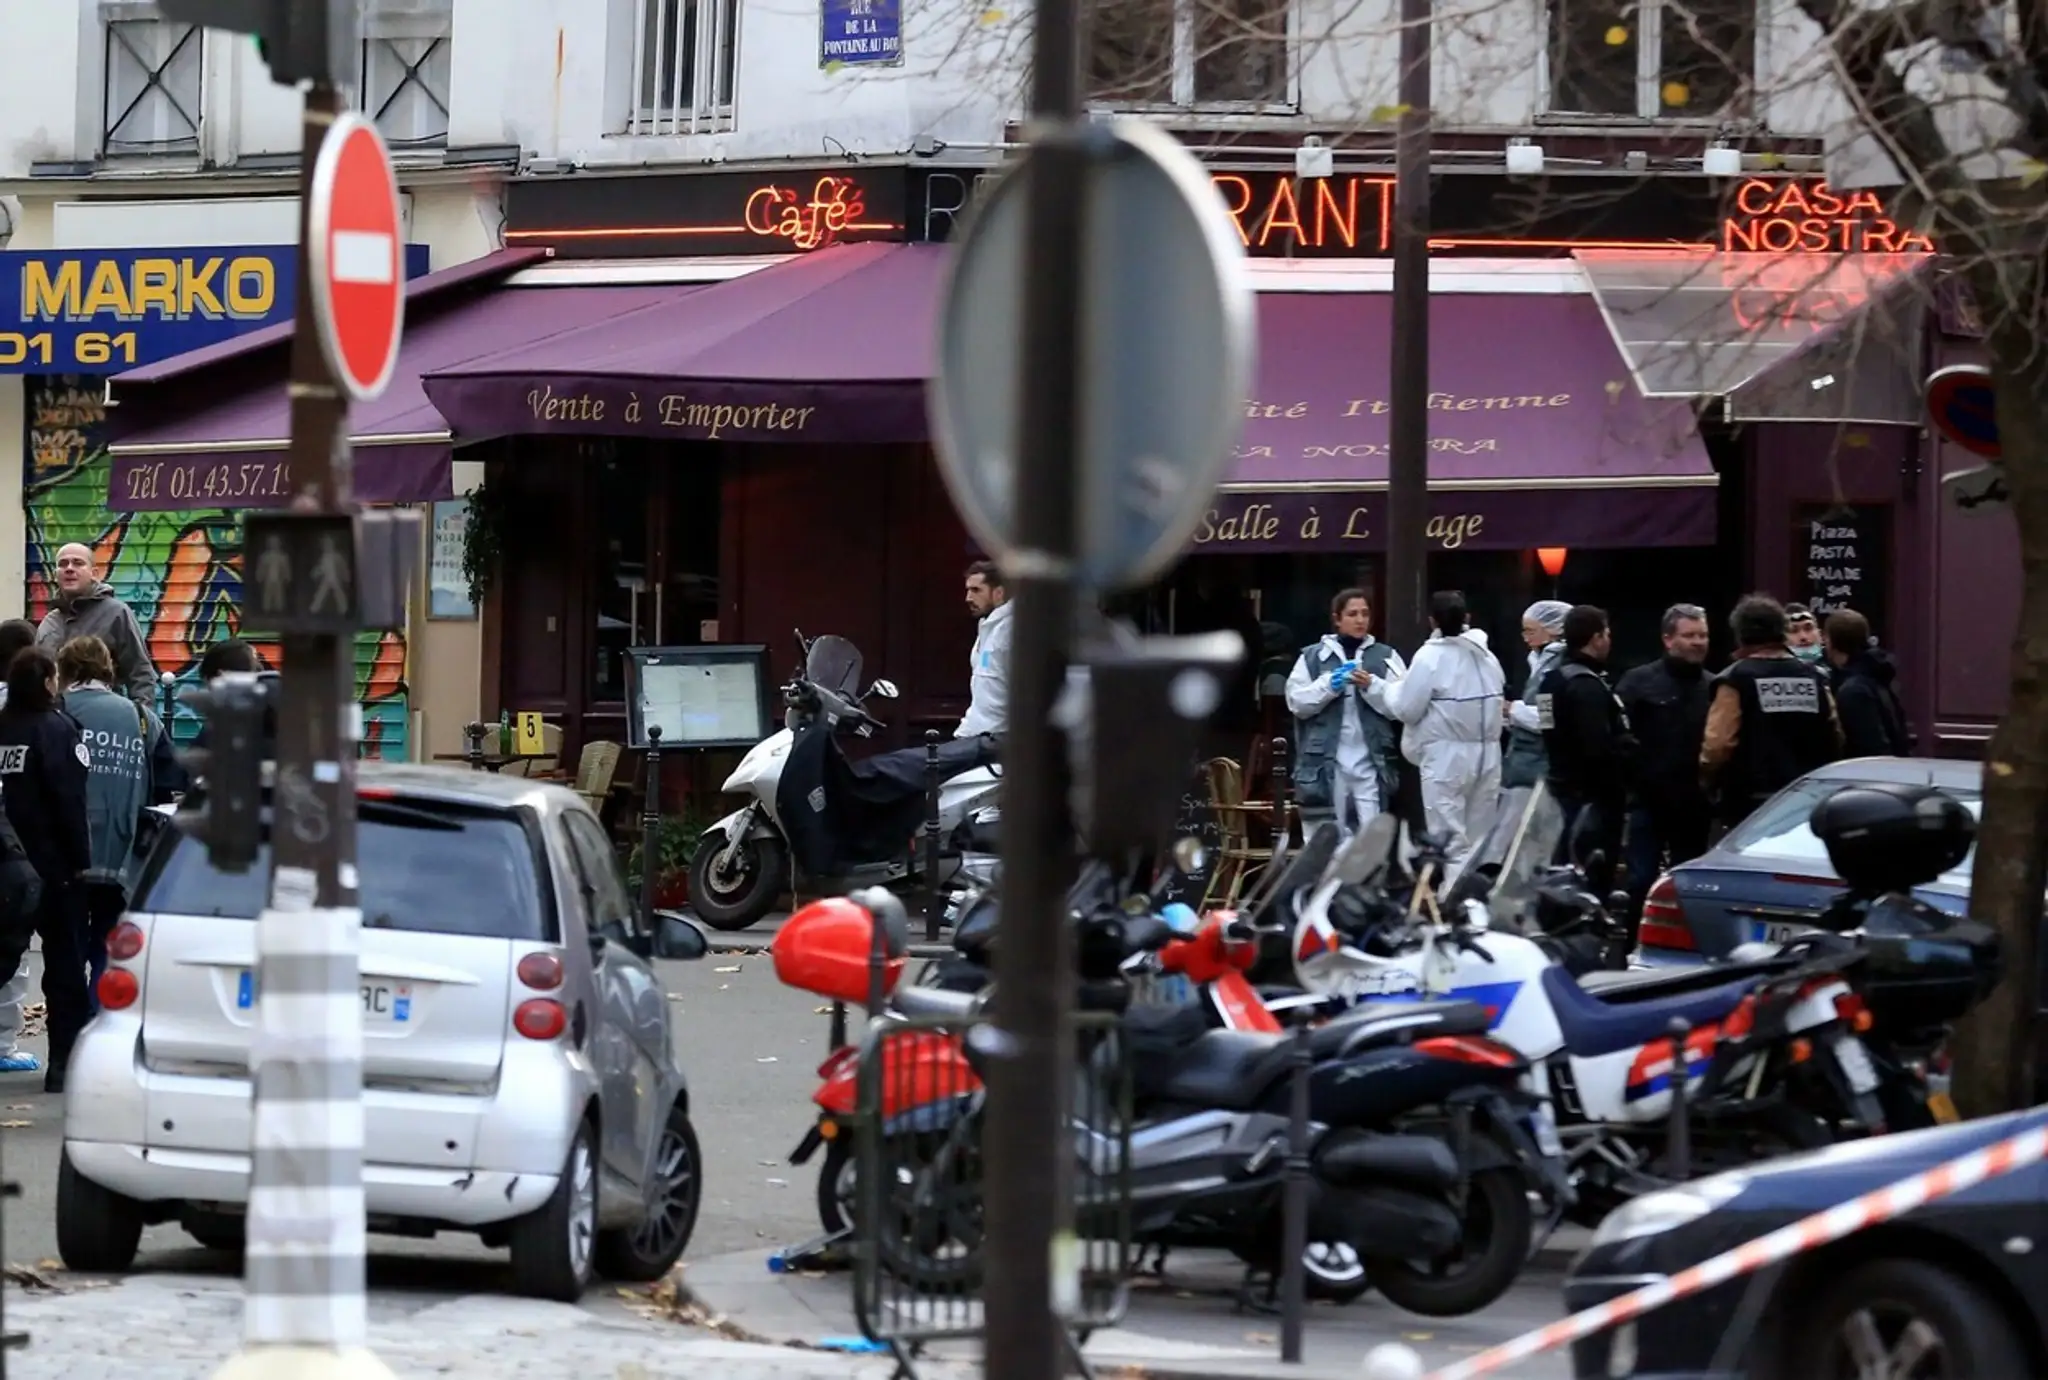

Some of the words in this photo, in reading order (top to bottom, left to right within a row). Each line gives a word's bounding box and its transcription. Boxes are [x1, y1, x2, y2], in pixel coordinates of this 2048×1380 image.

[845, 19, 860, 34] DE
[863, 19, 877, 33] LA
[823, 38, 868, 55] FONTAINE
[869, 38, 881, 52] AU
[1737, 179, 1883, 215] CASA
[744, 176, 849, 249] Café
[1723, 217, 1934, 252] NOSTRA
[22, 256, 276, 320] MARKO
[75, 332, 137, 363] 61
[527, 385, 605, 421] Vente
[624, 391, 642, 424] à
[658, 394, 815, 439] Emporter
[1339, 393, 1570, 418] Itlienne
[126, 462, 165, 500] Tél
[1193, 504, 1281, 544] Salle
[1300, 506, 1322, 539] à
[1425, 513, 1484, 549] age
[1810, 544, 1857, 560] PASTA
[1760, 682, 1816, 696] POLICE
[527, 714, 536, 738] 5
[82, 729, 145, 753] POLIC
[0, 748, 24, 771] ICE
